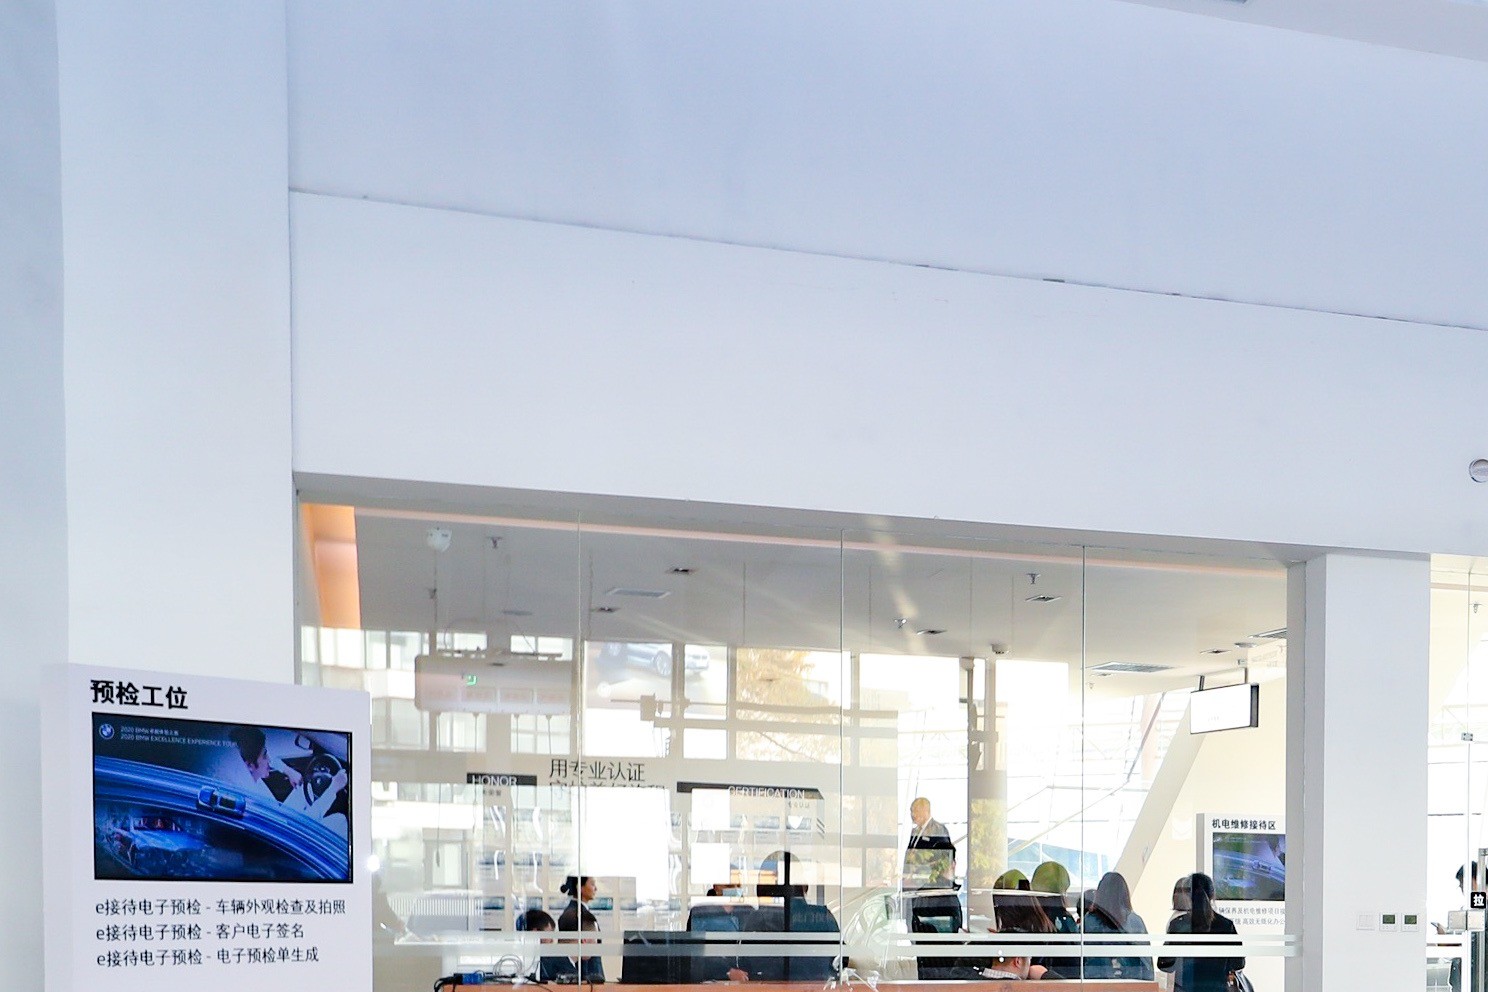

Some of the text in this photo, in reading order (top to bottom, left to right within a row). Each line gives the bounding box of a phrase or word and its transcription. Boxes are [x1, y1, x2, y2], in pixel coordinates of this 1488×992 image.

[90, 679, 188, 709] 预检工位
[150, 735, 186, 744] EXCELLENCE
[187, 738, 221, 746] EXPERIENCE
[550, 759, 646, 782] 用专业认证
[472, 775, 517, 786] HONOR
[728, 785, 805, 799] CERTIFICATION
[1212, 818, 1276, 830] 机电维修接待区
[95, 899, 201, 915] e接待电子预检
[215, 899, 346, 915] 车辆外观检查及拍照
[1473, 894, 1485, 906] 拉
[96, 924, 201, 941] e接待电子预检
[216, 923, 304, 939] 客户电子签名
[97, 949, 202, 967] e接待电子预检
[217, 947, 319, 964] 电子预检单生成
